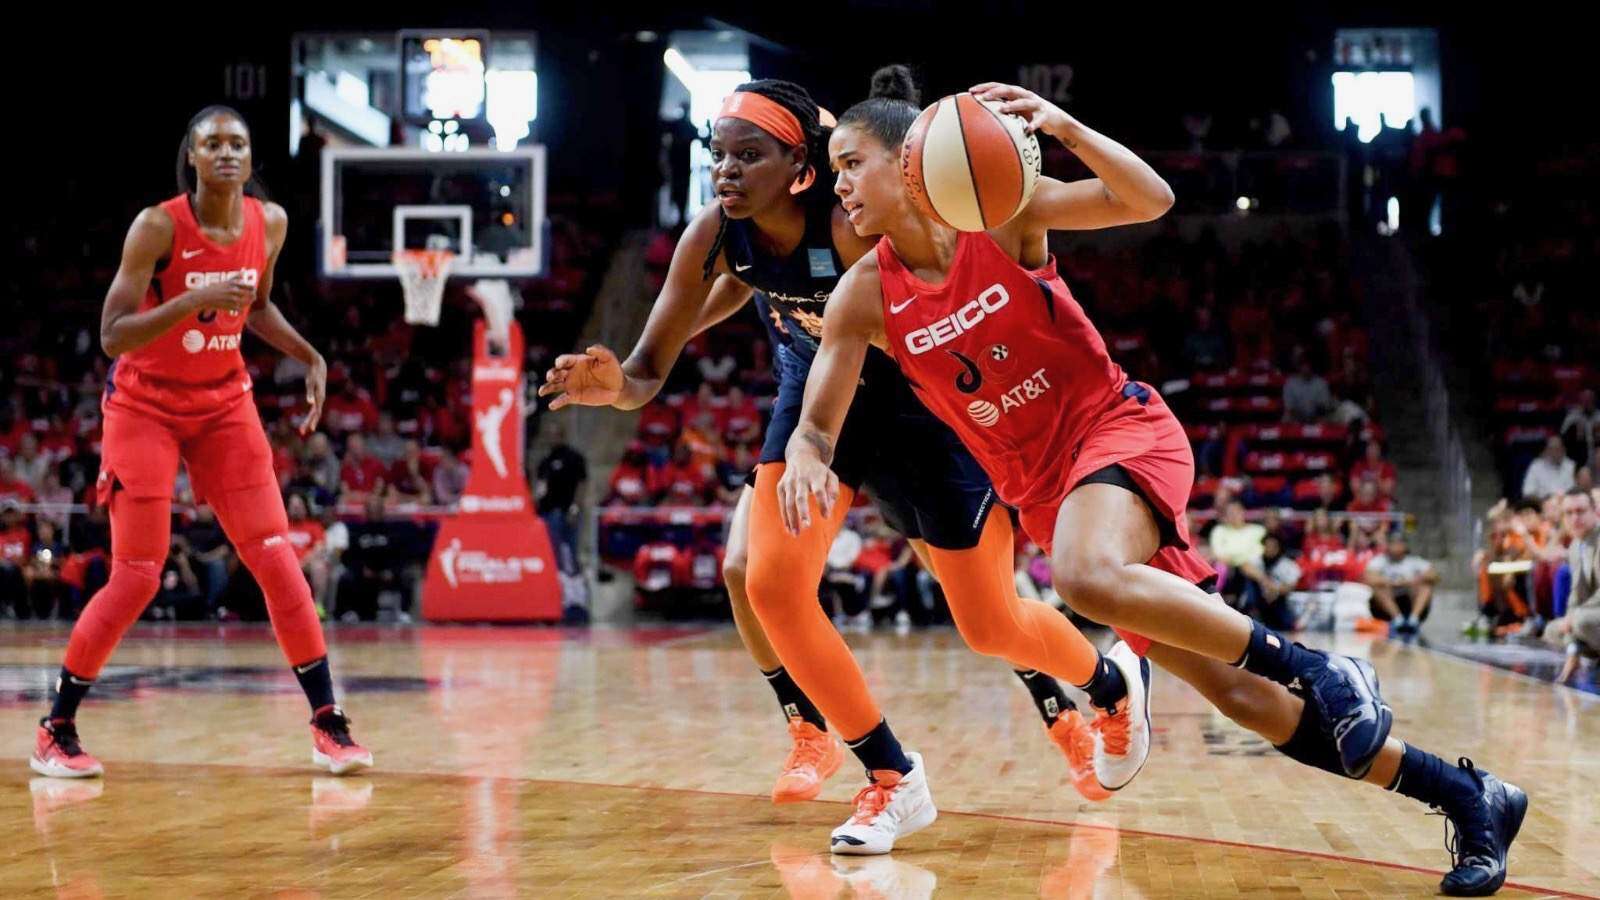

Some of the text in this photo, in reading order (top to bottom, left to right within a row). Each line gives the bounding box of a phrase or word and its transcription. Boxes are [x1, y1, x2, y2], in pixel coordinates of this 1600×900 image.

[225, 63, 268, 100] 101
[1018, 64, 1074, 102] 102
[904, 282, 1010, 355] GEICO
[1000, 367, 1051, 414] AT&T
[972, 487, 993, 529] CONNECTICUT
